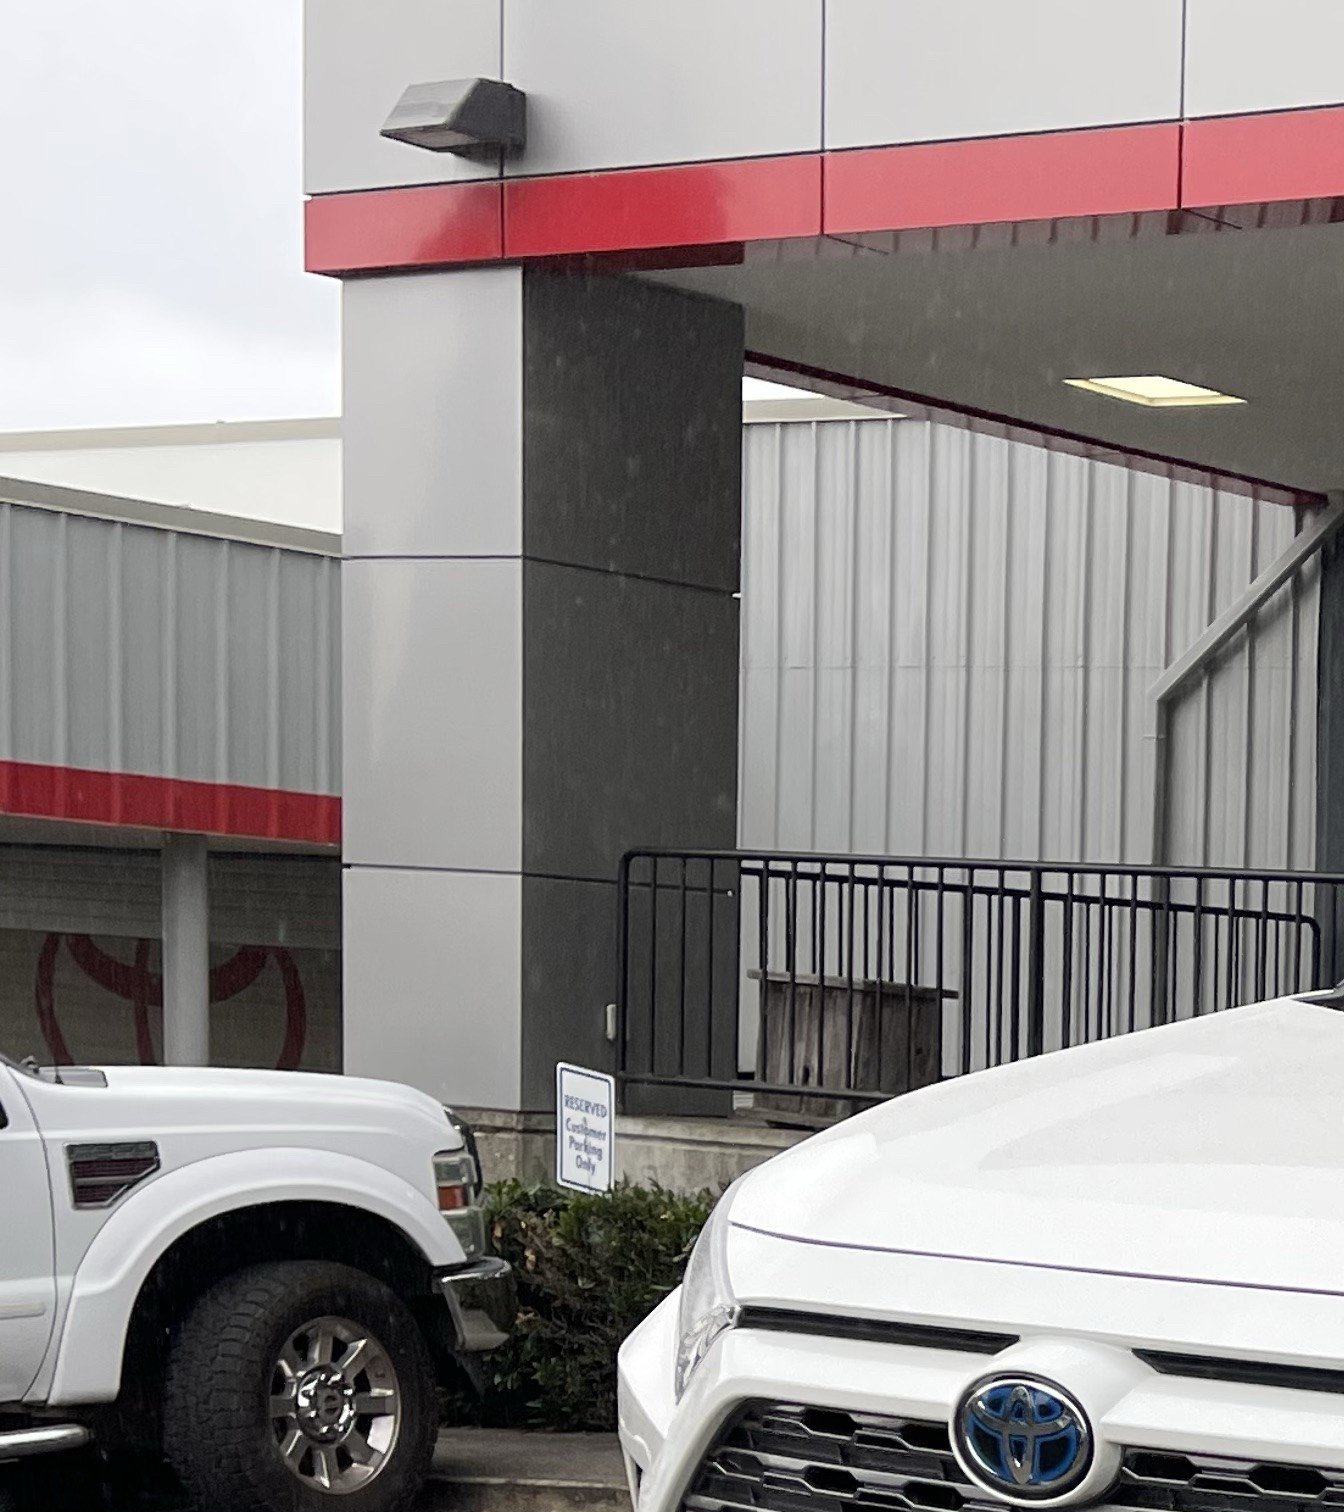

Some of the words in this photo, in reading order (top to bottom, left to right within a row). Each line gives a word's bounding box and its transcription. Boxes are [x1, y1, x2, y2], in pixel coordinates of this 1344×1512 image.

[564, 1094, 608, 1119] RESERVED
[566, 1117, 607, 1141] Customer
[569, 1135, 603, 1162] Parking
[576, 1155, 596, 1176] Only
